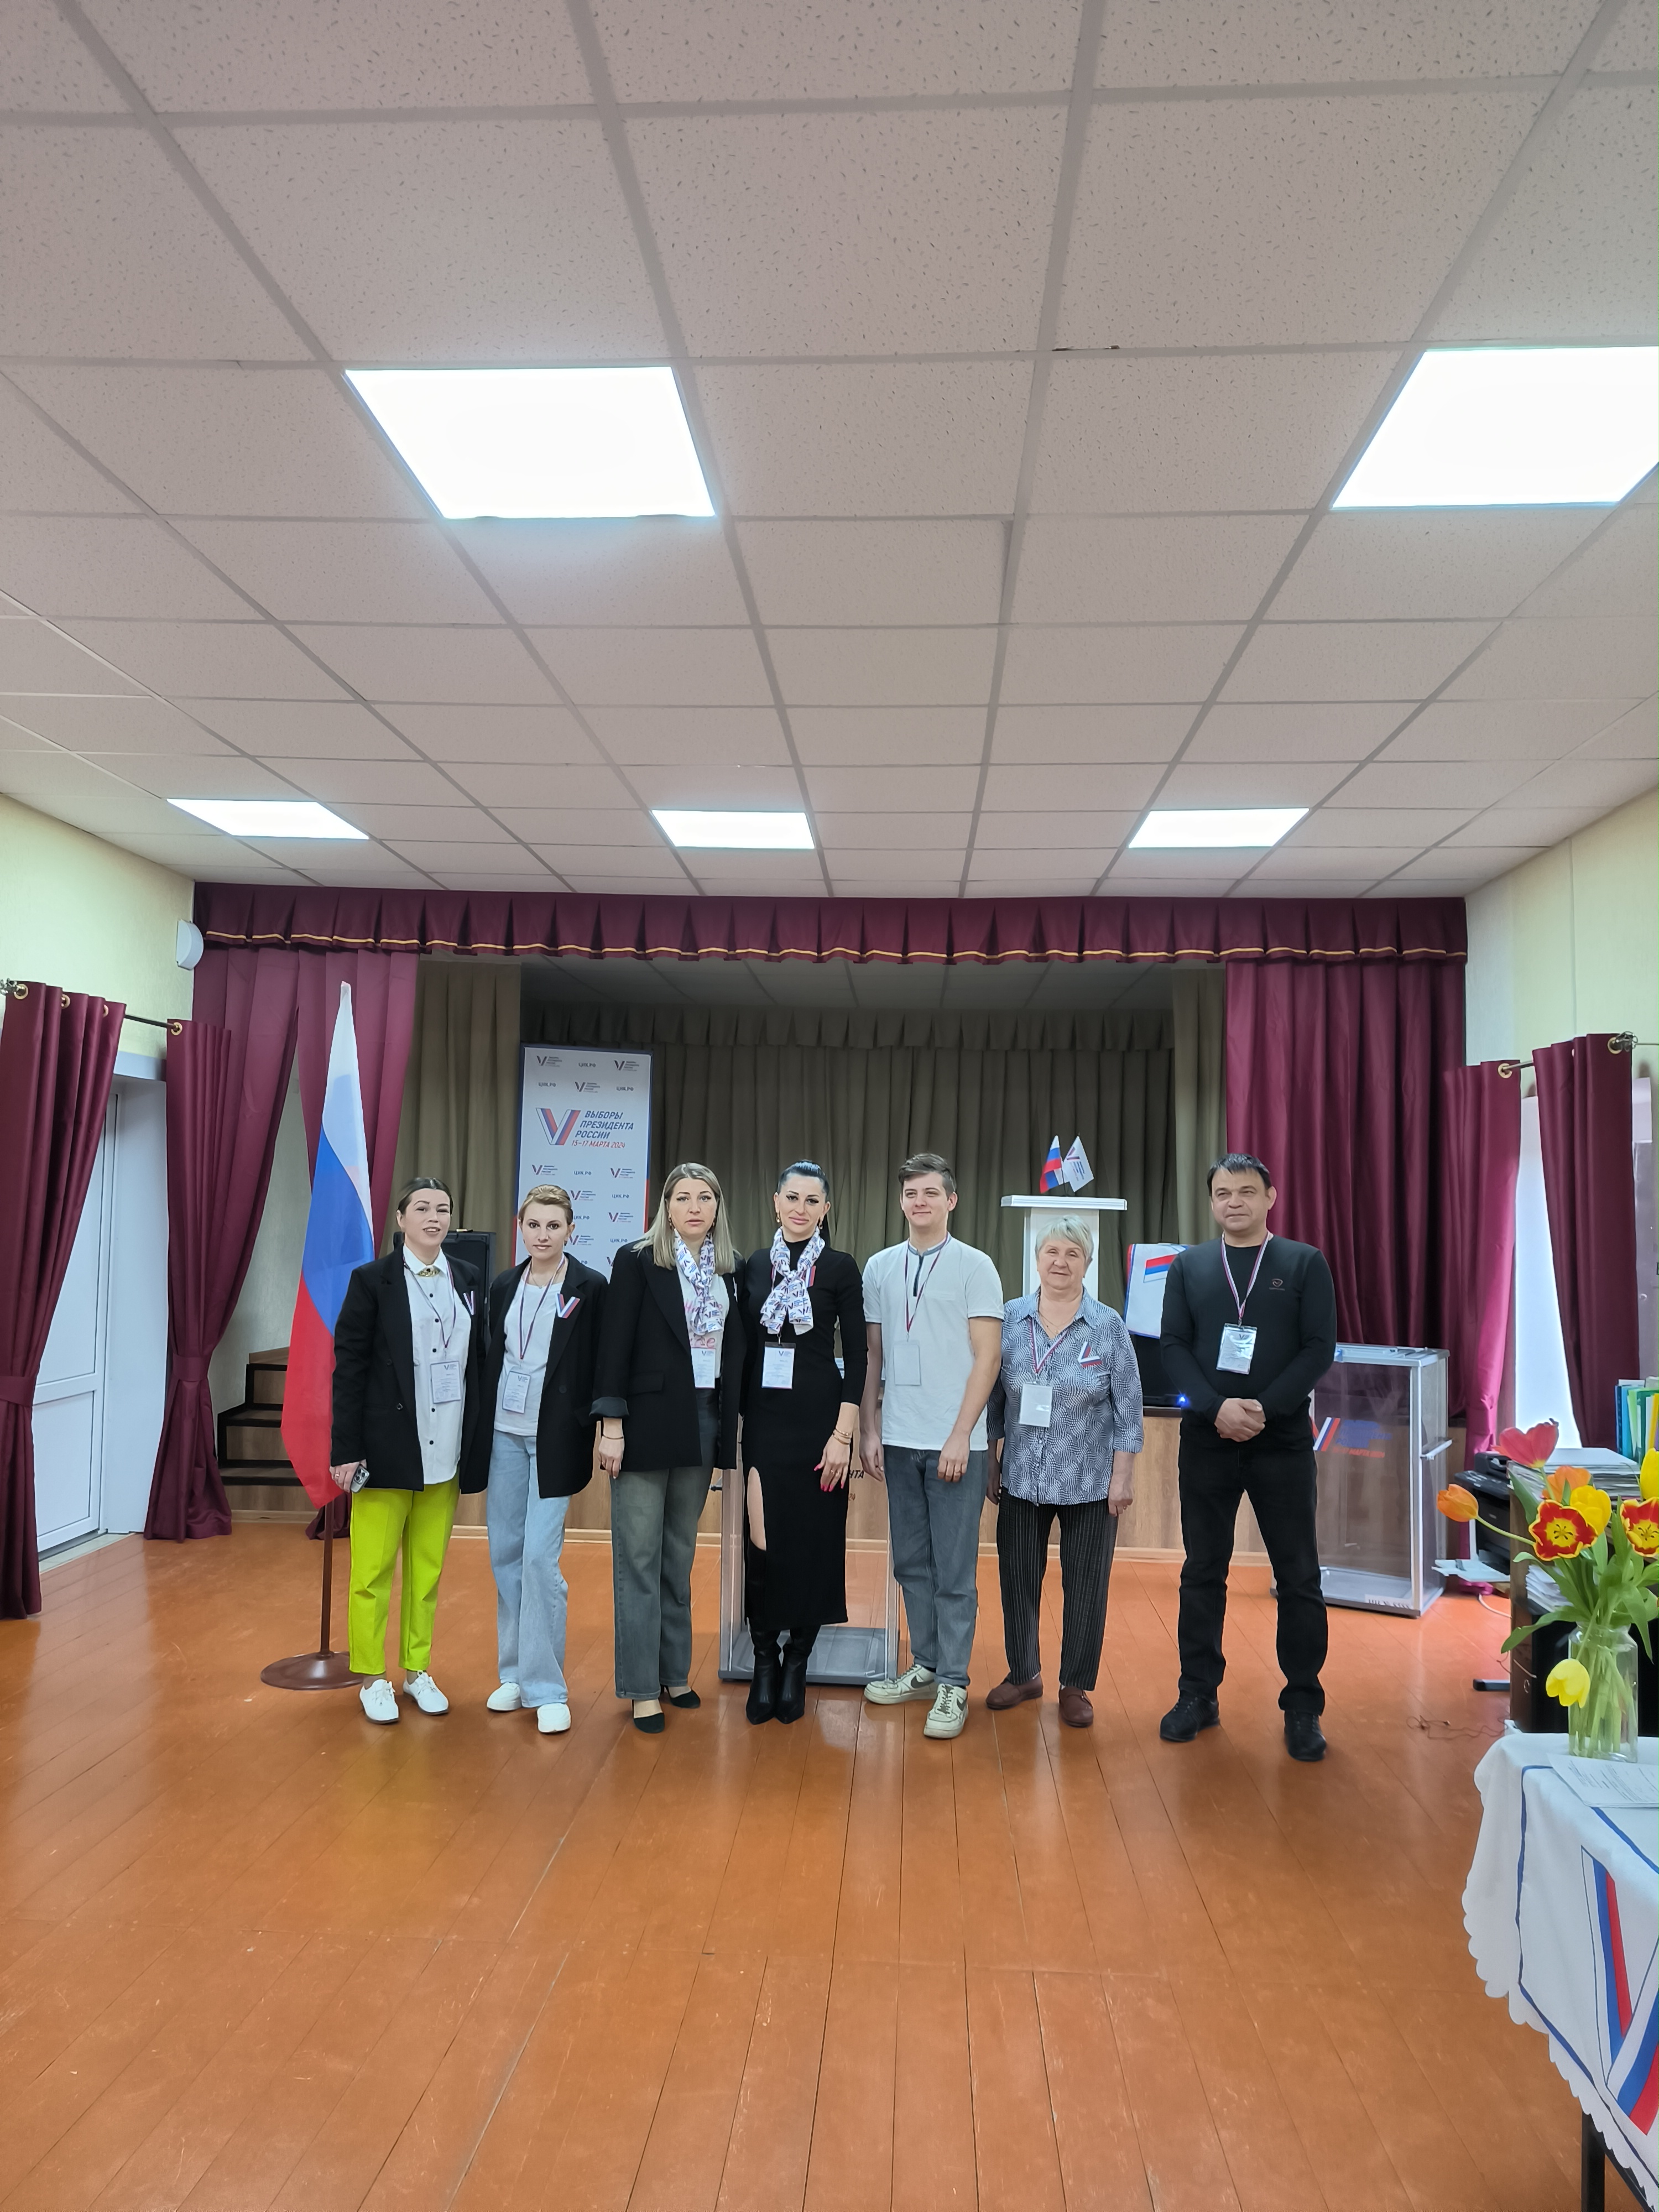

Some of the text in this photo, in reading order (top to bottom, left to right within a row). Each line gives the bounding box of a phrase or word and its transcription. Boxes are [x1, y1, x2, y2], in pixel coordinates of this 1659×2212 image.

[585, 1110, 623, 1119] ВЫБОРЫ
[580, 1120, 634, 1130] ПРЕЗИДЕНТА
[575, 1130, 611, 1139] РОССИИ
